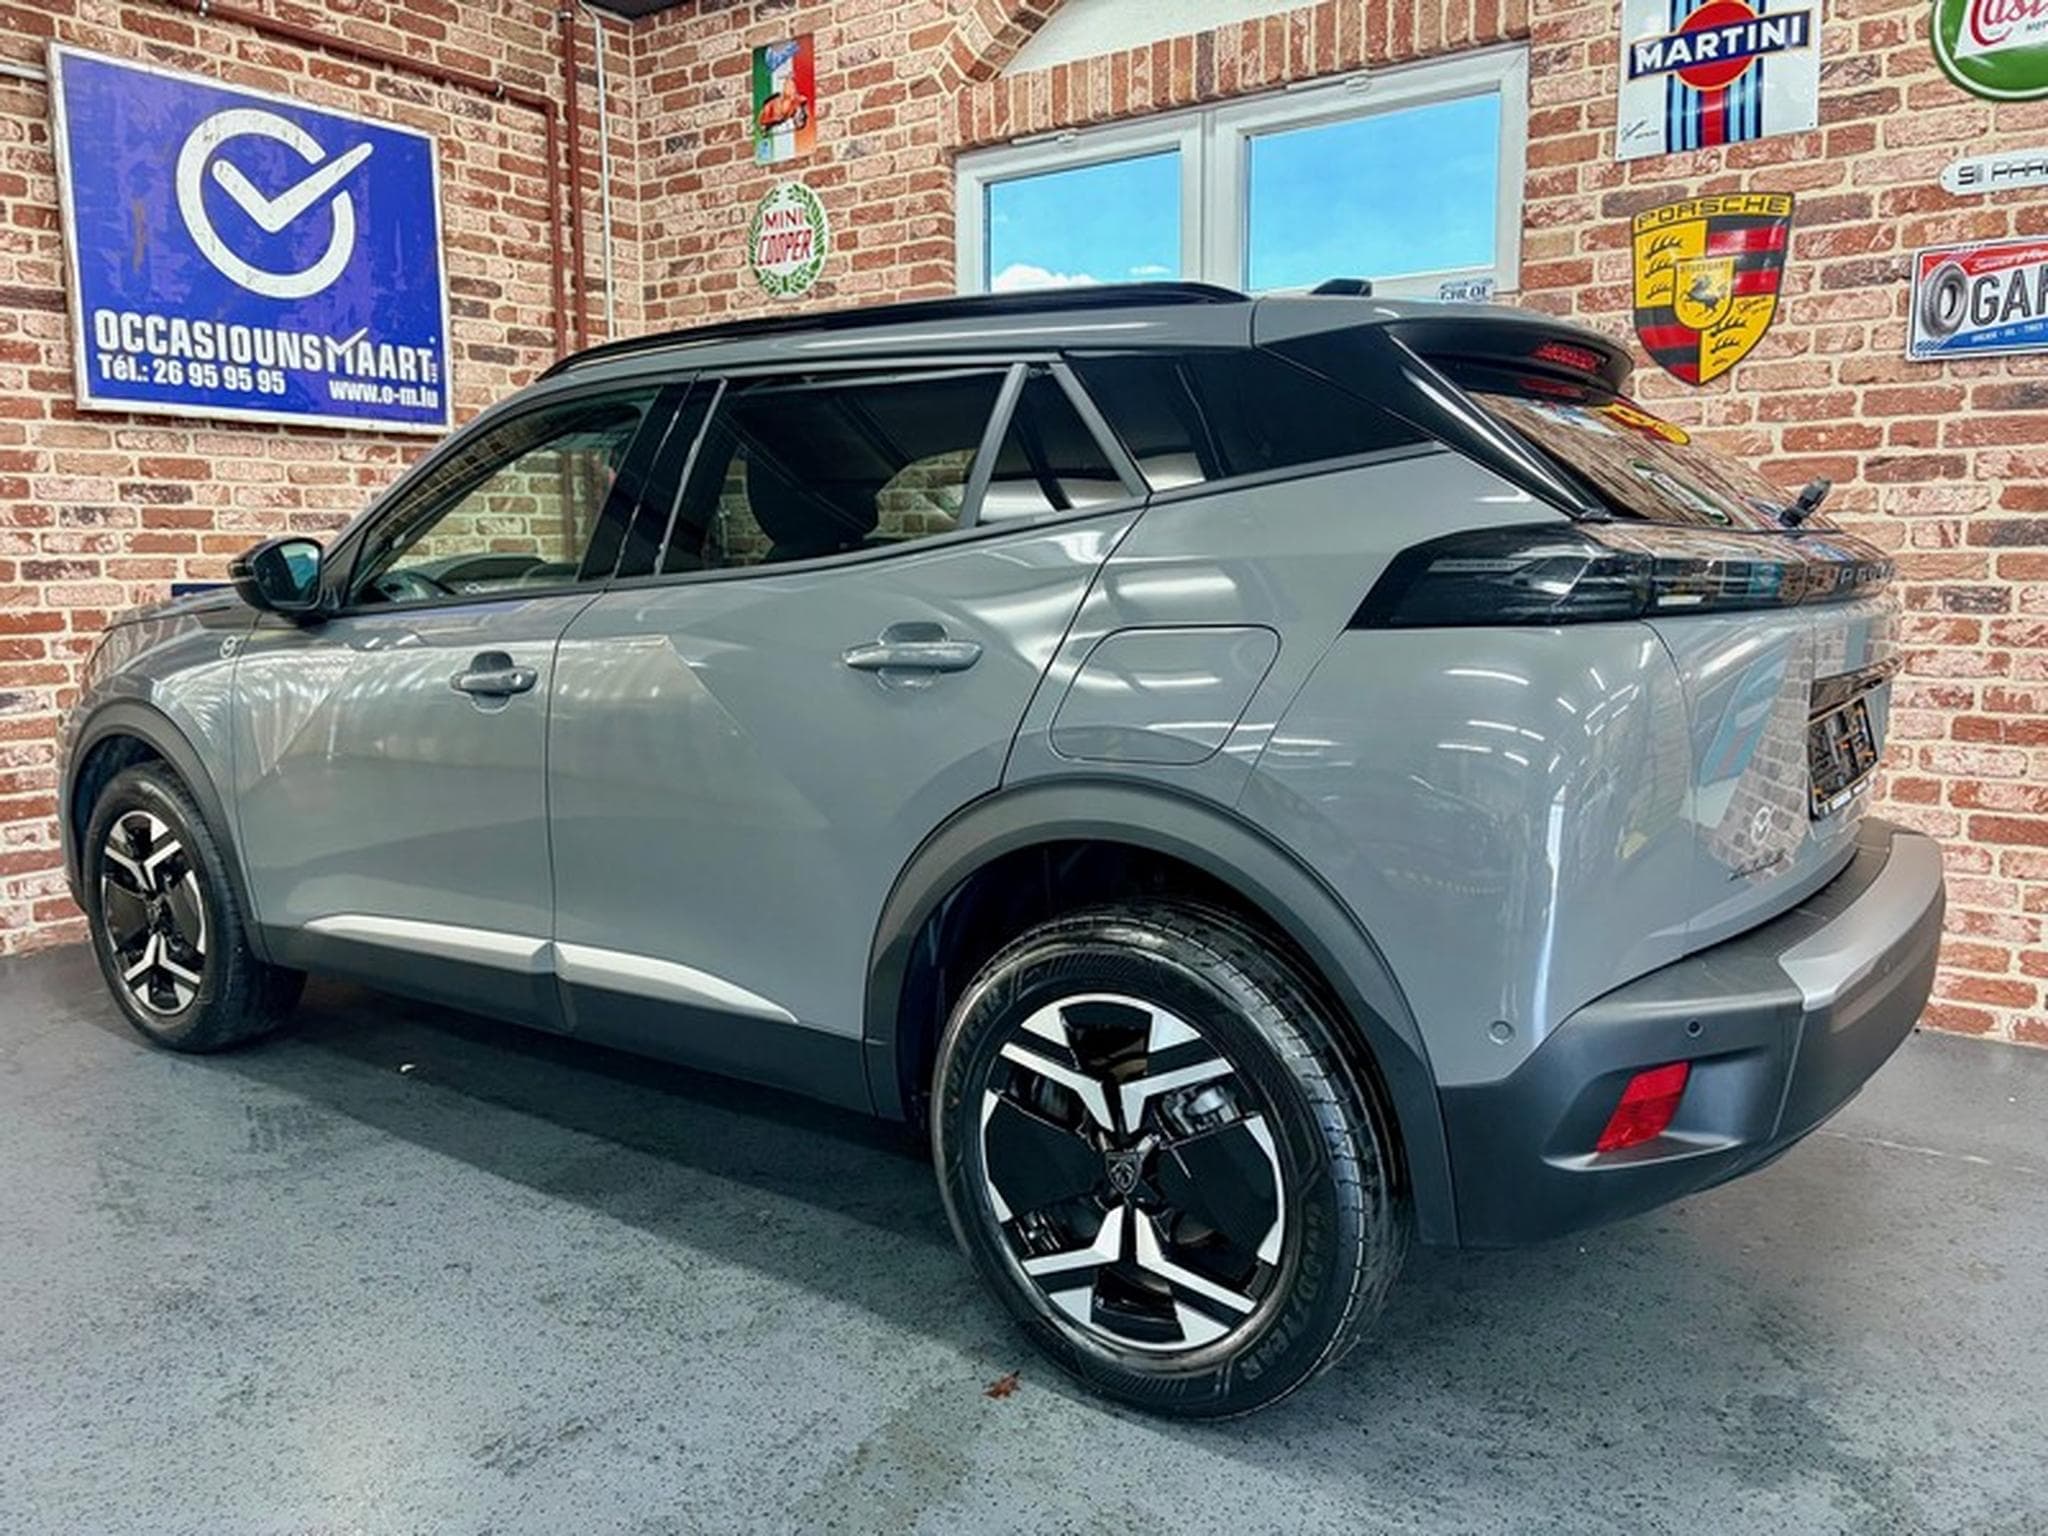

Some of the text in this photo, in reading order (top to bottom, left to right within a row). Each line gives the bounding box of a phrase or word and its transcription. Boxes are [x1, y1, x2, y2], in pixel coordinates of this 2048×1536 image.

[1635, 15, 1801, 74] MARTINI
[765, 207, 804, 230] MINI
[1637, 196, 1788, 230] PORSCHE
[757, 229, 813, 266] COOPER
[152, 358, 185, 386] 26
[188, 361, 219, 389] 95
[222, 364, 253, 392] 95
[257, 369, 286, 396] 95
[329, 380, 438, 409] www.o-m.lu
